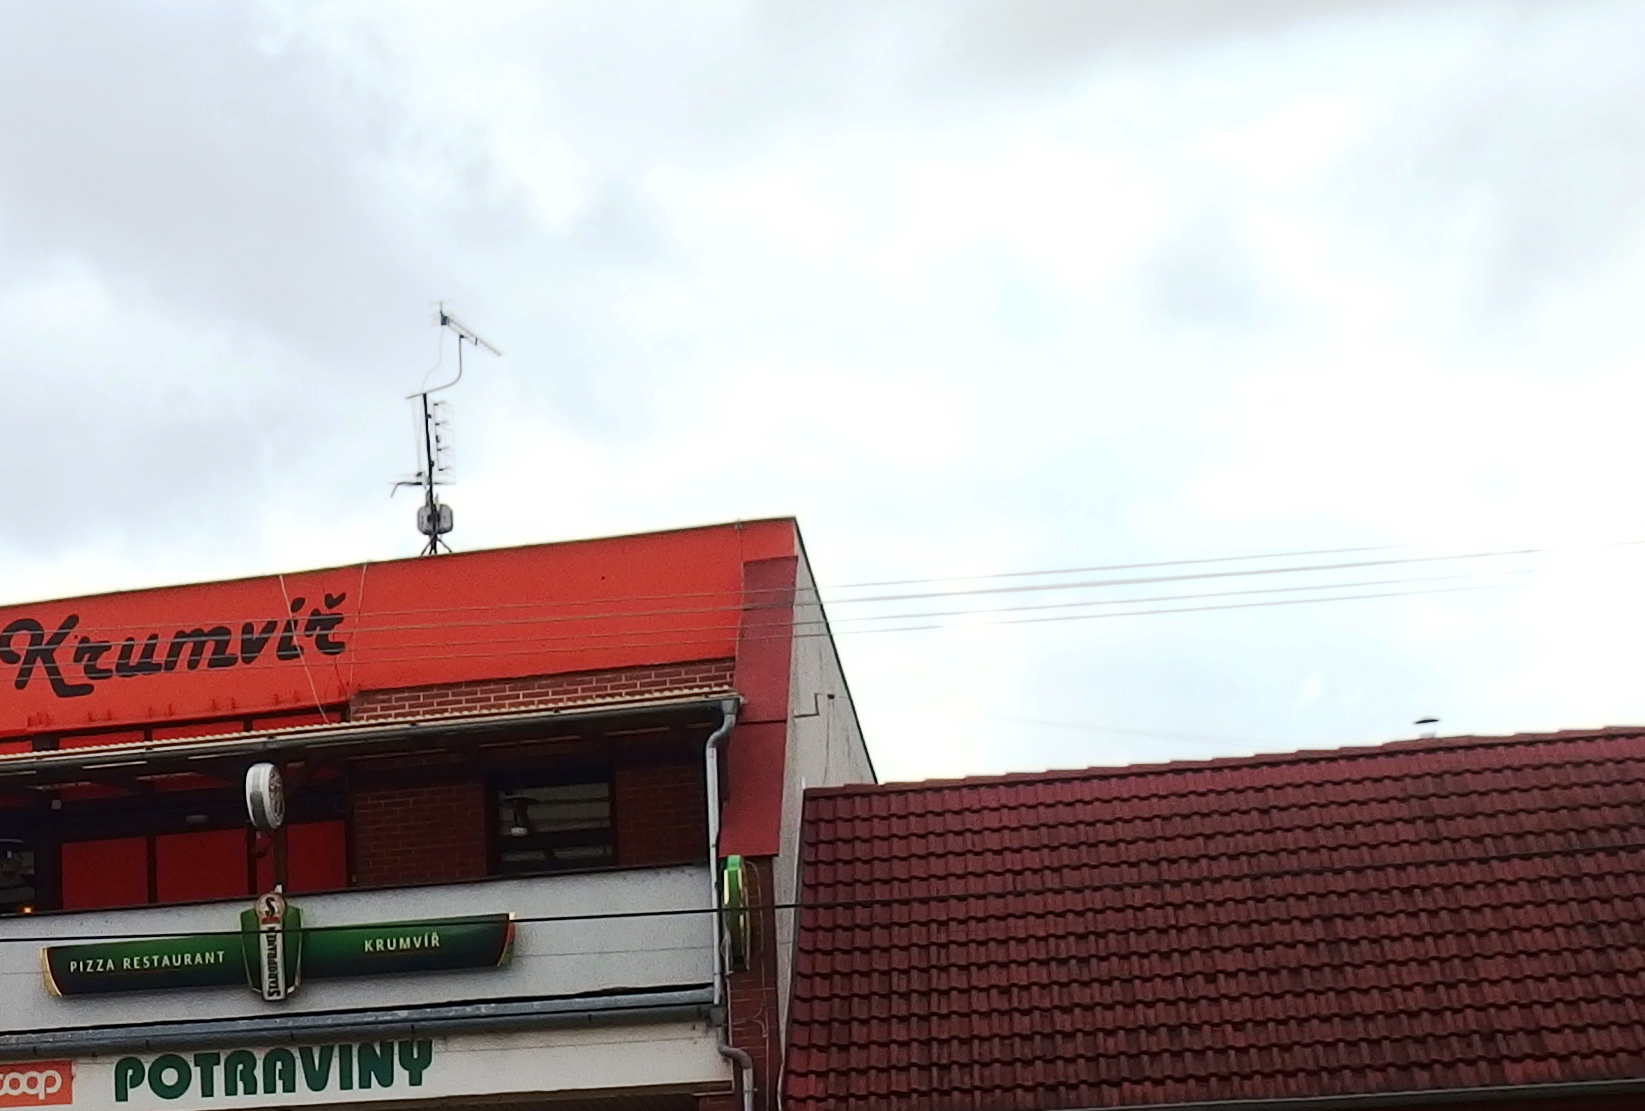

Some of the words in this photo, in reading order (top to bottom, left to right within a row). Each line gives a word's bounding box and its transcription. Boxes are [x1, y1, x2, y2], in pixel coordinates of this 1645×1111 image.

[364, 931, 441, 953] KRUMVÍŘ
[69, 959, 116, 974] PIZZA
[123, 950, 226, 971] RESTAURANT
[114, 1040, 433, 1103] POTRAVINY
